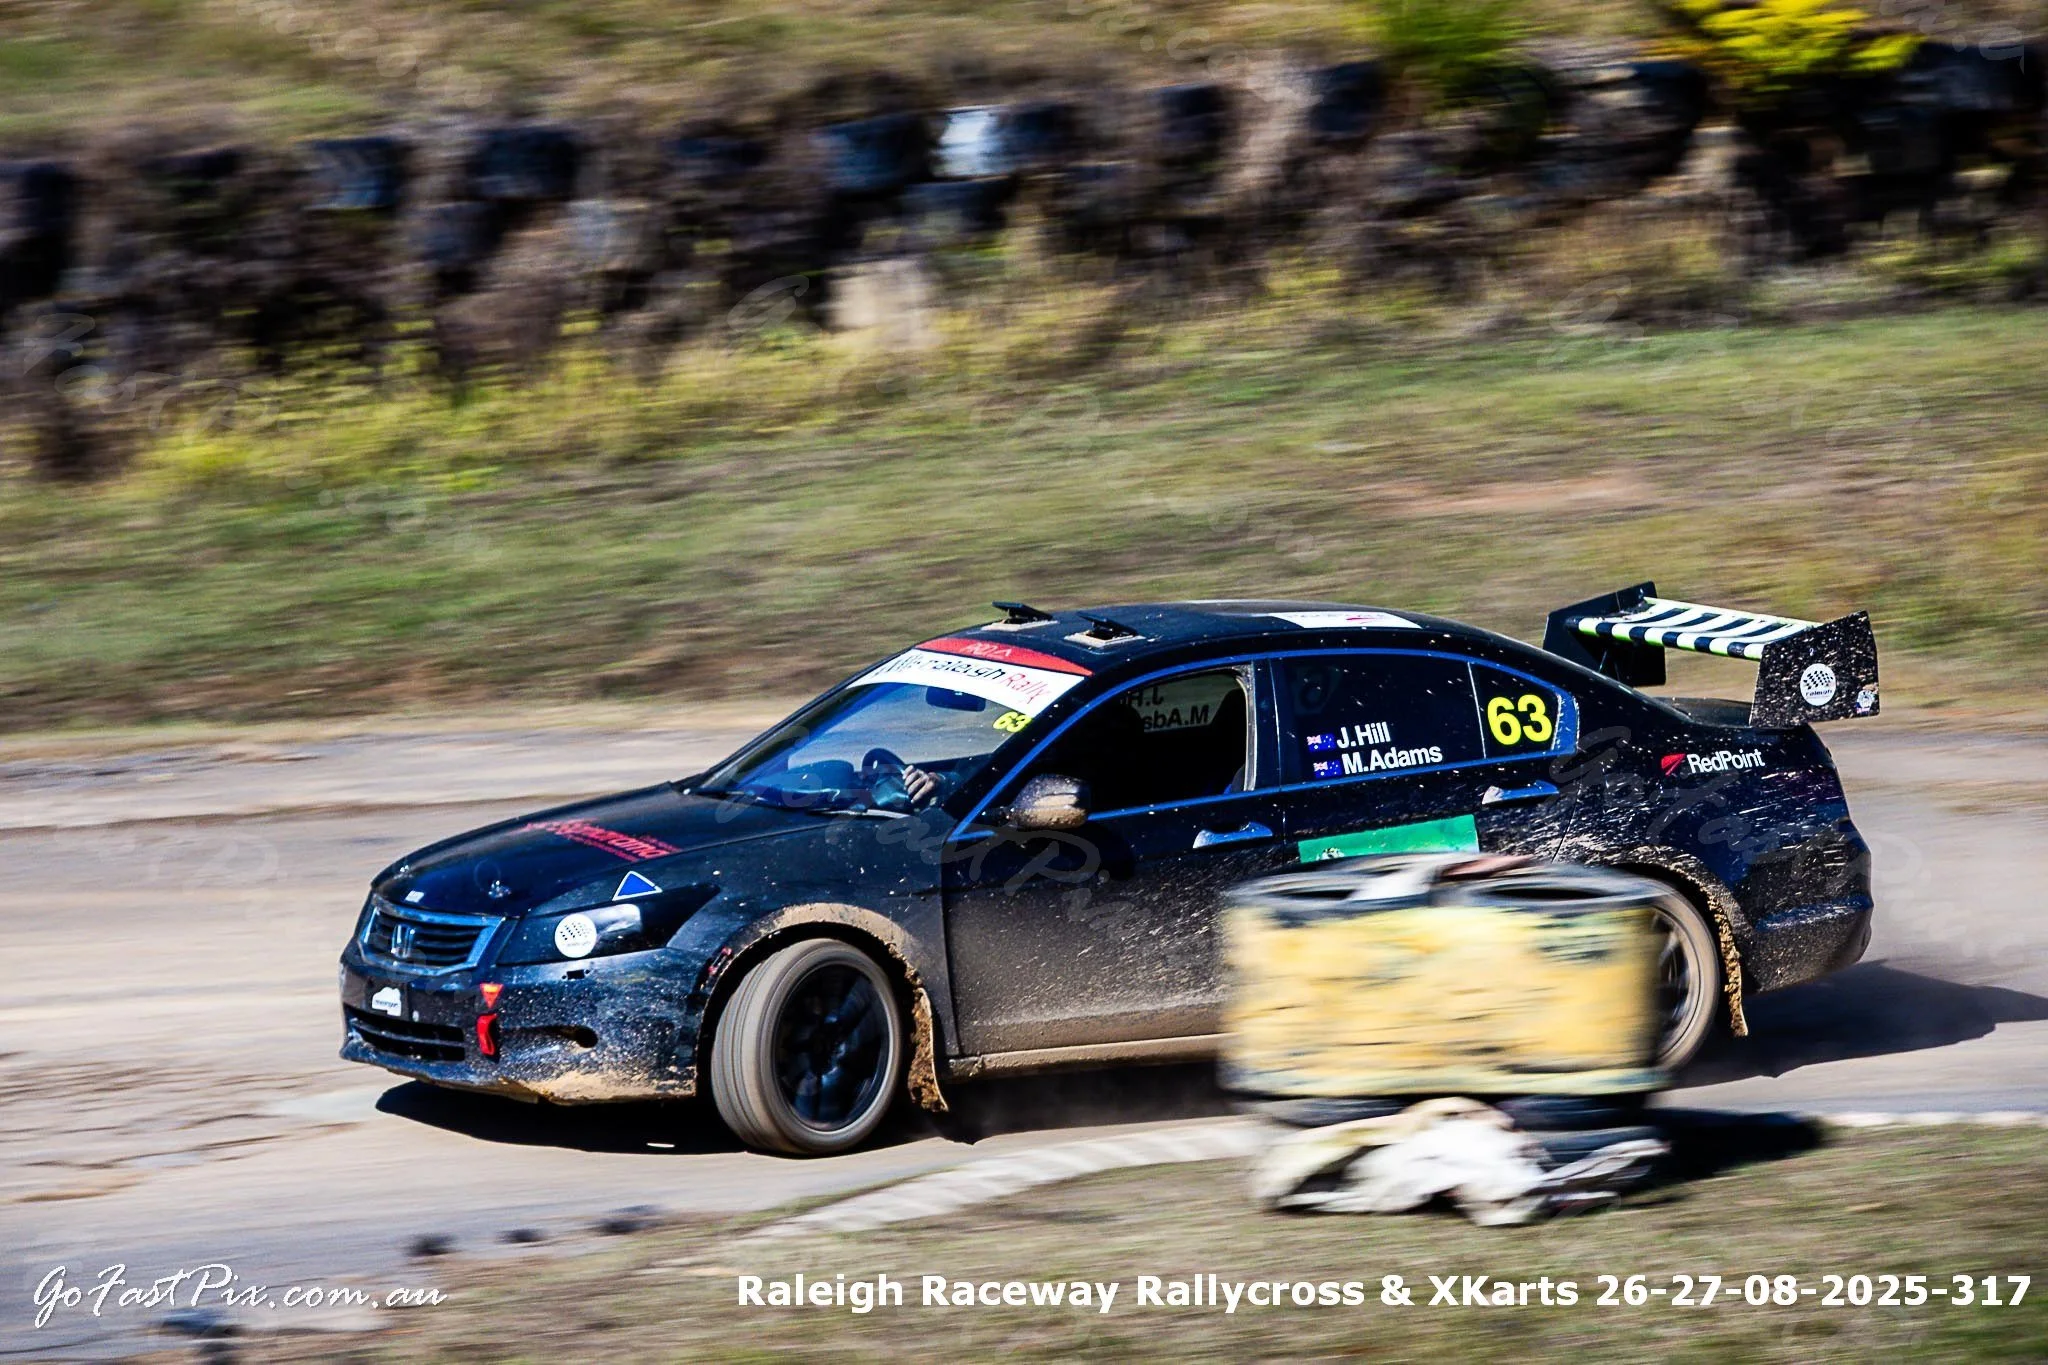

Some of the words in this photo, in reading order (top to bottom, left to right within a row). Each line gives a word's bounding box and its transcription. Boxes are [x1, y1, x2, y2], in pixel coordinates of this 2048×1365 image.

[992, 710, 1034, 733] 63
[1485, 694, 1554, 746] 63
[1336, 721, 1392, 749] J.Hill
[1341, 745, 1444, 775] M.Adams
[1687, 747, 1766, 775] RedPoint
